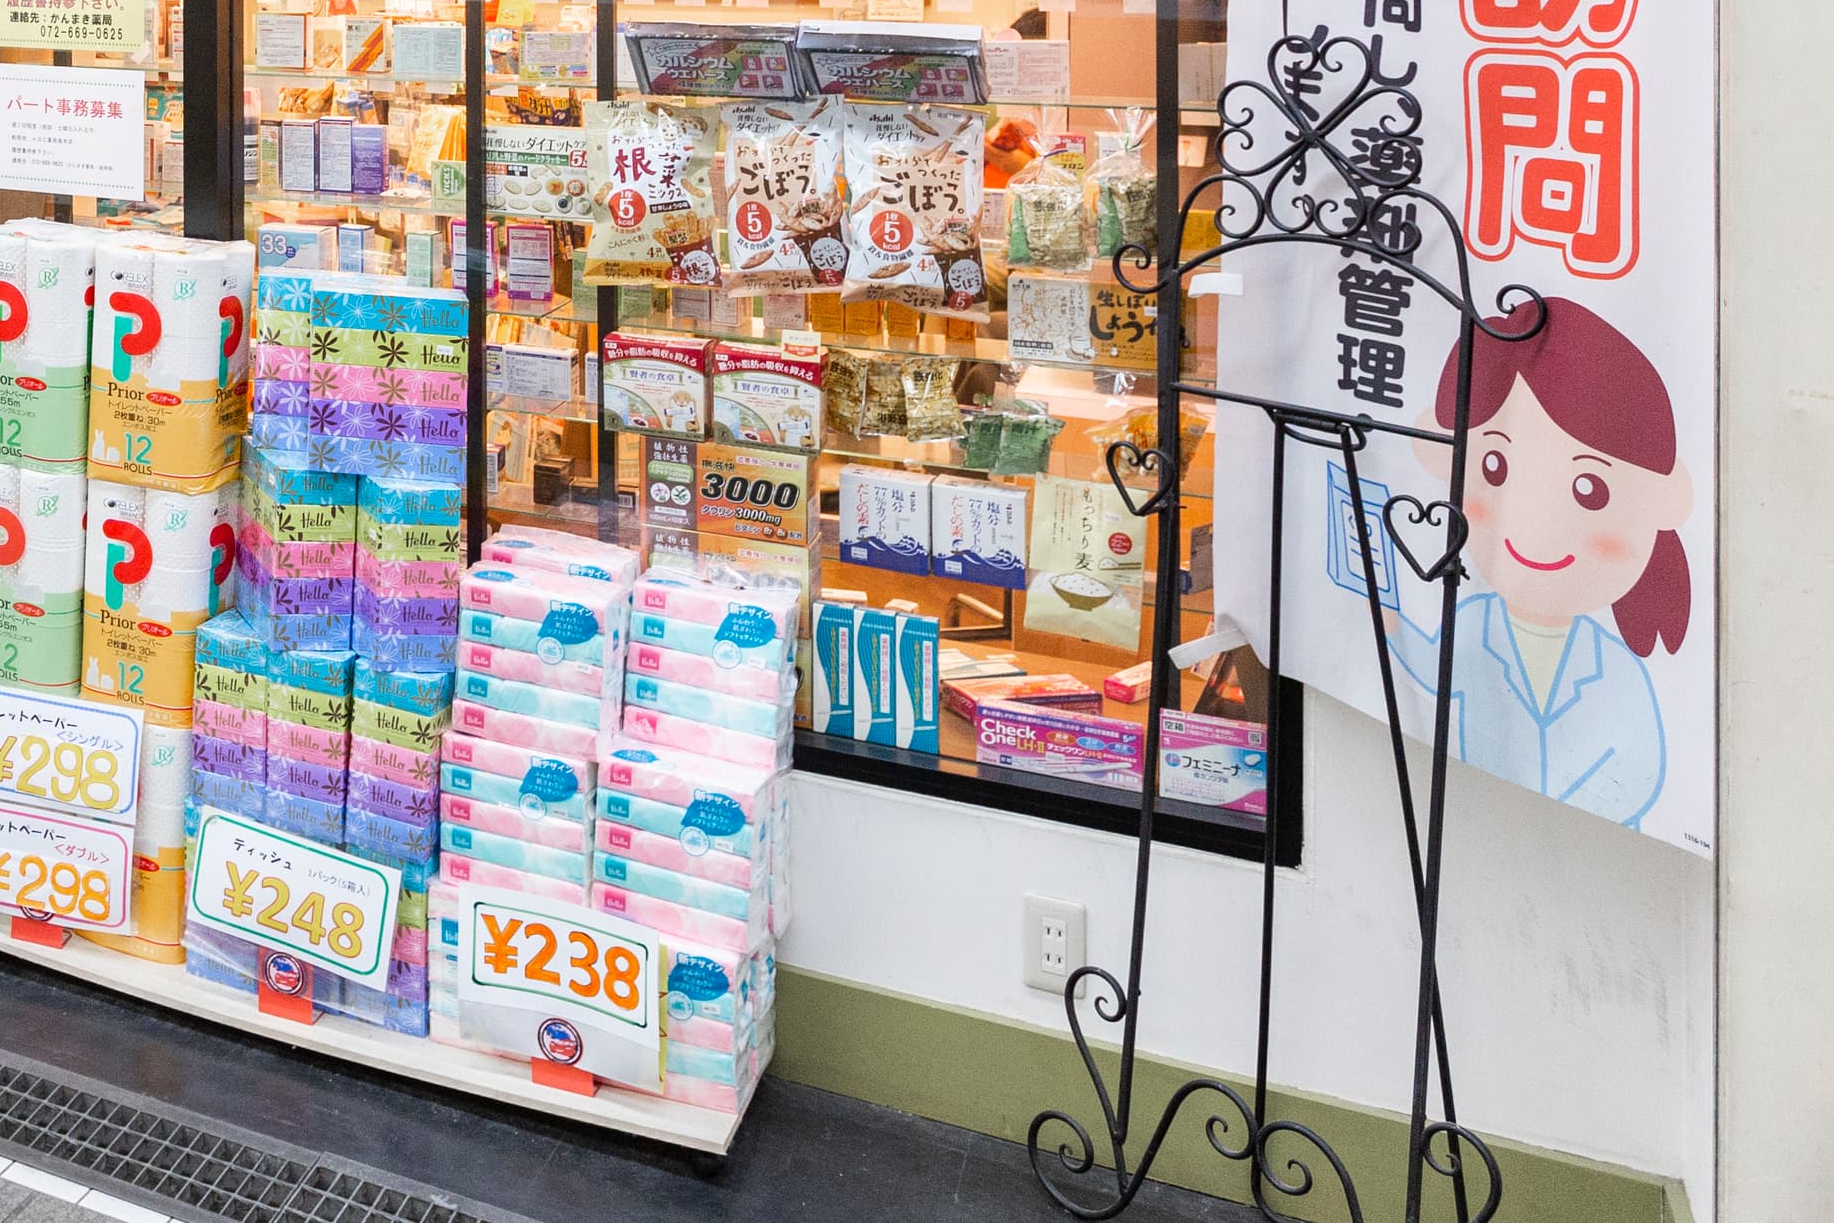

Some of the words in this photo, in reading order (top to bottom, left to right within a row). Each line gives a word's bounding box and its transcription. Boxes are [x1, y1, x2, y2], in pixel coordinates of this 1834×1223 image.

[40, 25, 123, 41] 072-669-0625
[656, 55, 735, 71] カルシウム
[829, 64, 913, 81] カルシウム
[666, 67, 729, 81] ウエハース
[7, 96, 124, 120] パート事務募集
[869, 113, 894, 122] Asahi
[443, 166, 452, 195] VICKS
[917, 167, 962, 181] つくった
[880, 172, 965, 214] ごぼう。
[618, 197, 635, 218] 5
[617, 216, 636, 227] kcal
[746, 211, 763, 232] 5
[883, 221, 901, 243] 5
[261, 232, 287, 255] 33
[747, 231, 764, 241] kcal
[881, 241, 903, 251] kcal
[607, 346, 698, 368] 糖分や脂肪の吸収を抑える
[629, 368, 677, 383] 賢者の食卓
[717, 359, 814, 382] 糖分や脂肪の吸収を抑える
[107, 381, 145, 402] Prior
[421, 382, 461, 403] Hello
[741, 381, 791, 396] 賢者の食卓
[0, 397, 22, 408] 55m
[107, 400, 173, 416] トイレットペーパー
[113, 411, 145, 425] 2枚重ね
[147, 415, 167, 427] 30m
[419, 417, 460, 438] Hello
[124, 432, 153, 464] 12
[123, 461, 153, 477] ROLLS
[700, 471, 801, 512] 3000
[890, 487, 905, 514] 塩分
[300, 512, 332, 529] Hello
[986, 499, 1002, 527] 塩分
[403, 531, 437, 548] Hello
[1074, 487, 1097, 572] もっちり麦
[300, 549, 332, 566] Hello
[298, 585, 330, 602] Hello
[402, 605, 434, 622] Hello
[550, 599, 594, 617] 新デザイン
[728, 602, 774, 620] 新デザイン
[100, 609, 136, 631] Prior
[100, 628, 164, 647] トイレットペーパー
[106, 637, 137, 652] 2枚重ね
[139, 644, 158, 657] 30m
[118, 661, 145, 695] 12
[215, 674, 246, 694] Hello
[116, 690, 145, 705] ROLLS
[288, 694, 320, 715] Hello
[374, 711, 408, 734] Hello
[980, 718, 1037, 742] Check
[56, 729, 125, 752] <シングル>
[980, 731, 1017, 746] One
[532, 756, 575, 774] 新デザイン
[1181, 754, 1242, 777] フェミニーナ
[287, 766, 320, 787] Hello
[370, 785, 403, 808] Hello
[694, 789, 741, 809] 新デザイン
[54, 842, 111, 865] <ダブル>
[233, 837, 293, 871] ティッシュ
[222, 860, 366, 959] ¥248
[480, 913, 642, 1011] ¥238
